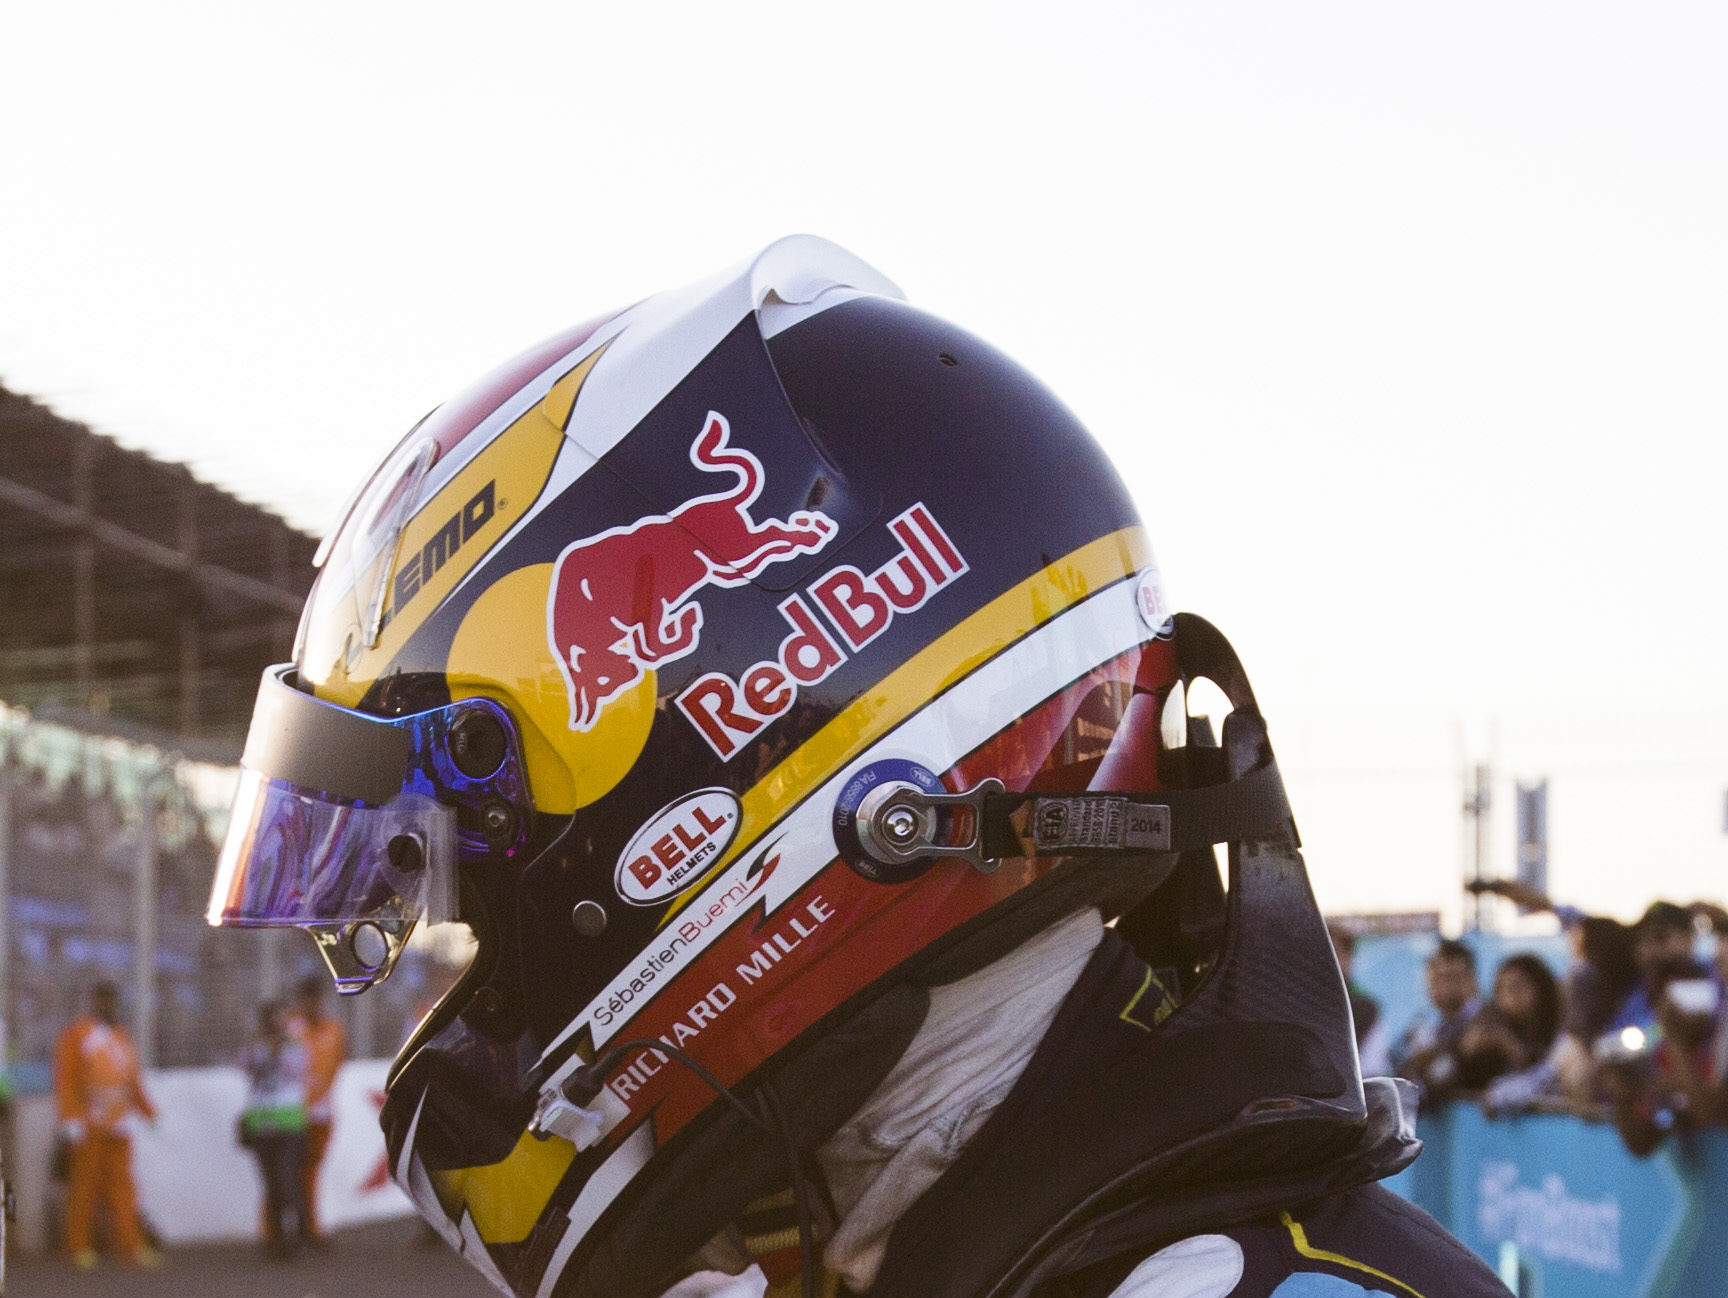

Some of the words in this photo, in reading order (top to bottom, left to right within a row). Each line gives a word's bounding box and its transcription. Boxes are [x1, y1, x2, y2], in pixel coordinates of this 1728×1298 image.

[675, 593, 848, 762] Red
[807, 502, 970, 652] Bull
[628, 806, 727, 890] BELL
[666, 841, 717, 886] HELMETS
[1131, 818, 1163, 835] 2014
[611, 982, 738, 1102] RICHARD
[736, 895, 837, 986] MILLE
